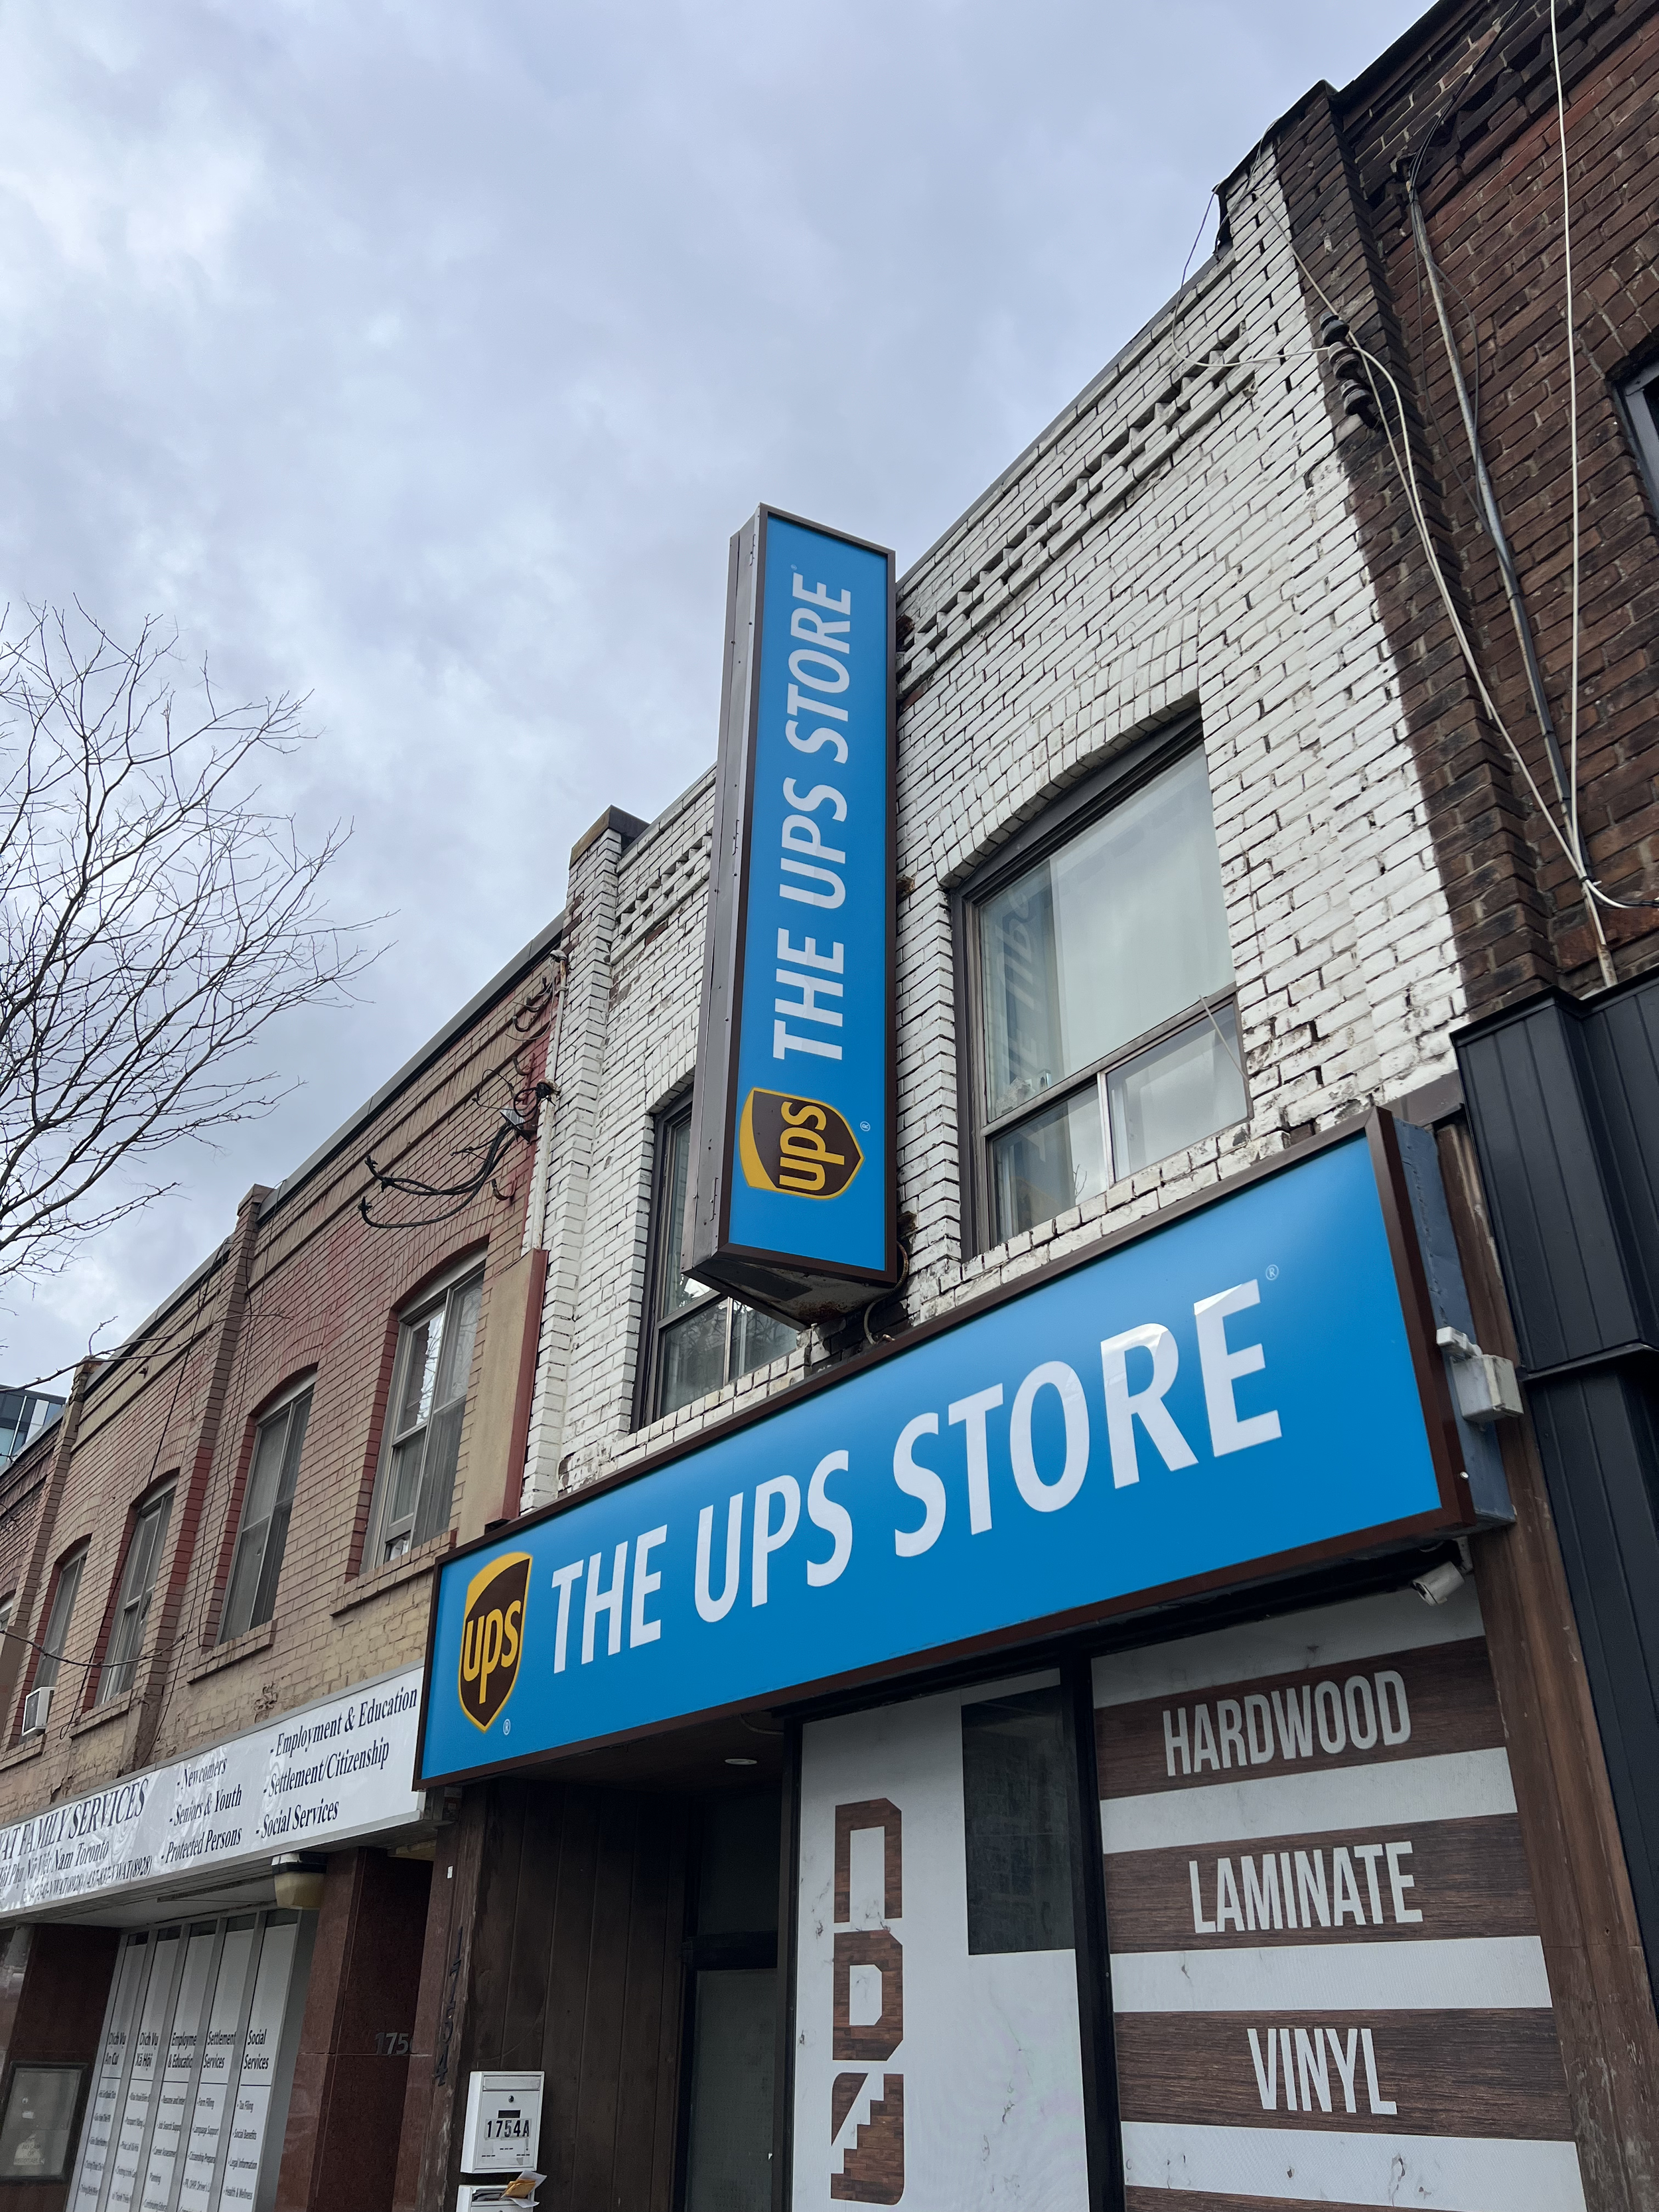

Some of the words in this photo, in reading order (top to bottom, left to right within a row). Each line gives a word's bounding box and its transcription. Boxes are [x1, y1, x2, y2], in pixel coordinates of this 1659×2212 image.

[786, 572, 851, 765] STORE
[780, 775, 848, 909] UPS
[773, 926, 844, 1061] THE
[551, 1524, 666, 1674] THE
[694, 1449, 855, 1624] UPS
[893, 1279, 1283, 1558] STORE
[275, 1712, 342, 1757] Employment
[344, 1706, 355, 1732] &
[358, 1686, 417, 1728] Education
[1162, 1670, 1412, 1777] HARDWOOD
[181, 1758, 228, 1790] Newcomers
[268, 1737, 390, 1797] Settlement/Citizenship
[17, 1806, 72, 1856] FAMILY
[68, 1778, 149, 1840] SERVICES
[174, 1800, 203, 1826] Seniors
[204, 1793, 212, 1816] &
[214, 1783, 242, 1813] Youth
[261, 1807, 291, 1838] Social
[292, 1798, 339, 1830] Services
[53, 1848, 74, 1872] Nam
[74, 1839, 109, 1867] Toronto
[165, 1832, 205, 1864] Protected
[204, 1828, 242, 1852] Persons
[1189, 1841, 1423, 1934] LAMINATE
[203, 2053, 225, 2069] Services
[244, 2053, 269, 2069] Services
[248, 2029, 267, 2045] Social
[374, 2032, 414, 2055] 175
[1246, 2028, 1398, 2115] VINYL
[486, 2120, 530, 2138] 1754A
